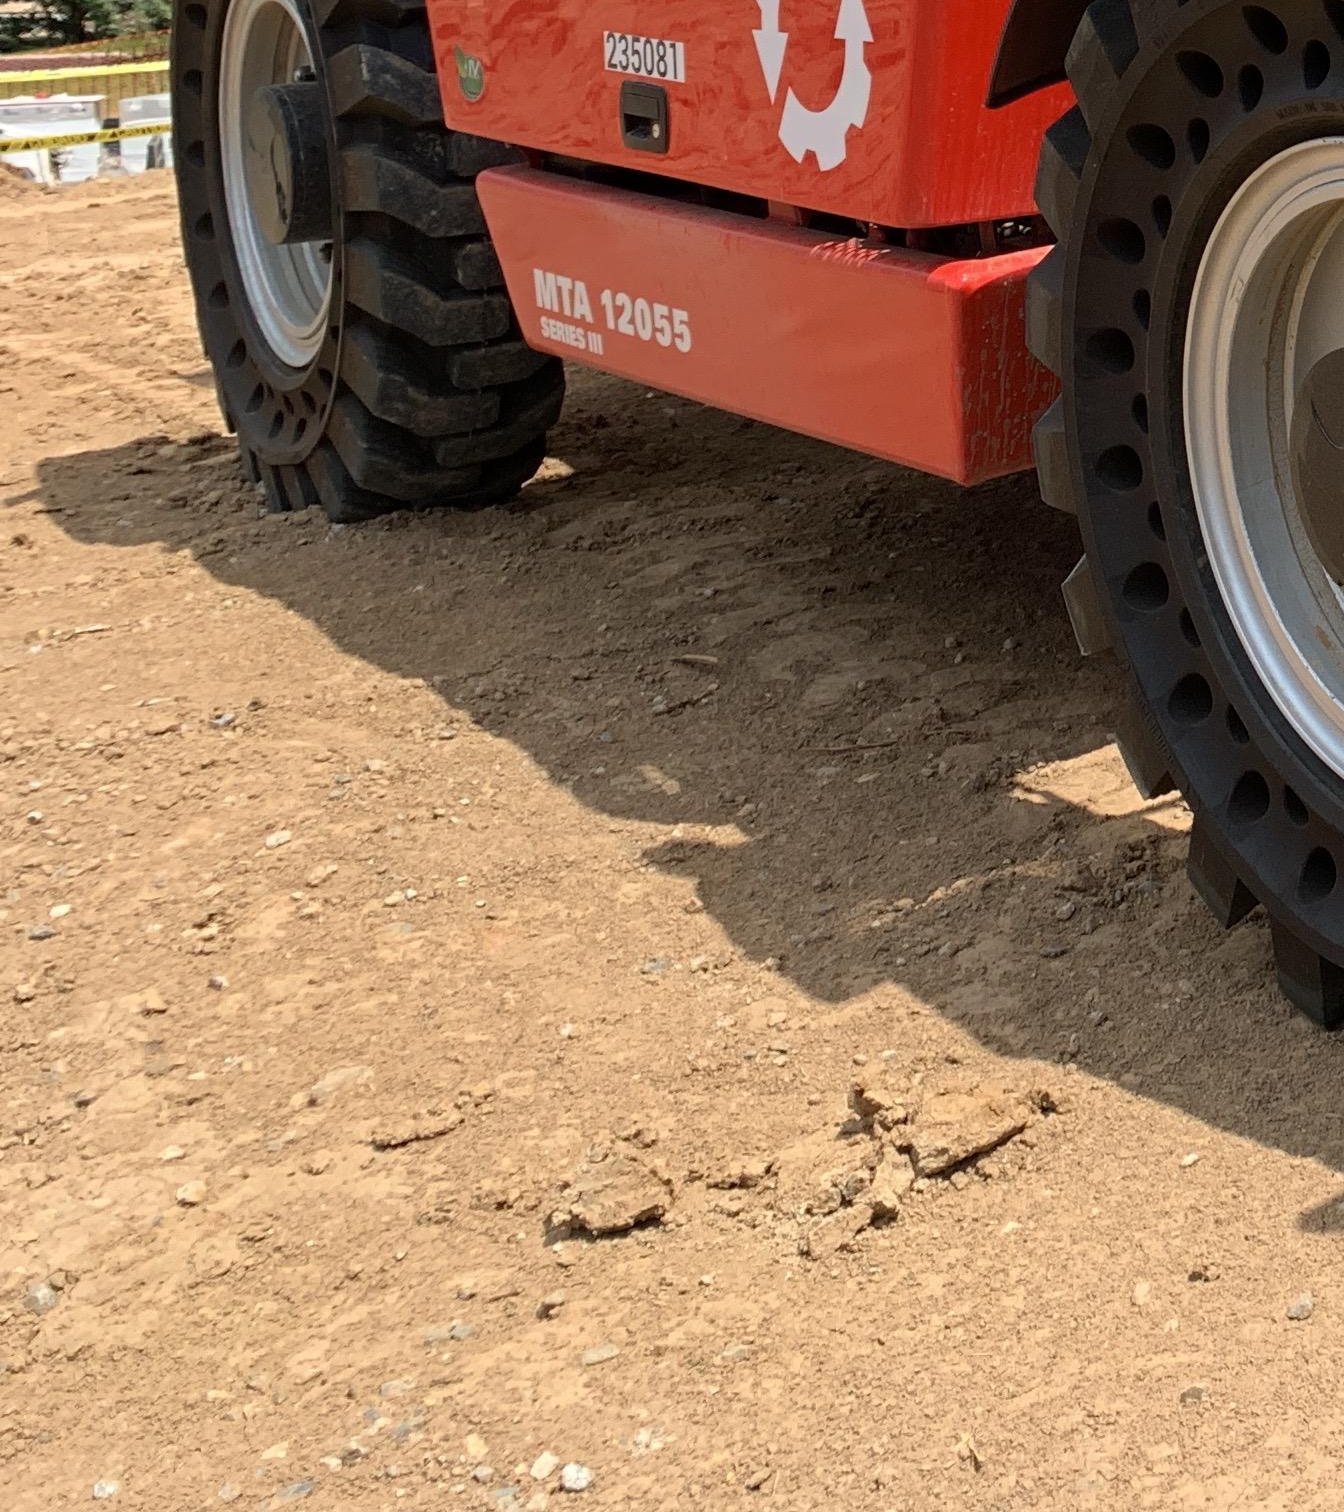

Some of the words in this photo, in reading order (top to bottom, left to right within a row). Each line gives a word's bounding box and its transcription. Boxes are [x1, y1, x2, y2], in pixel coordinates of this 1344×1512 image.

[606, 32, 678, 80] 235081
[533, 268, 594, 324] MTA
[600, 289, 692, 353] 12055
[540, 316, 587, 350] SERIES
[587, 331, 604, 356] III
